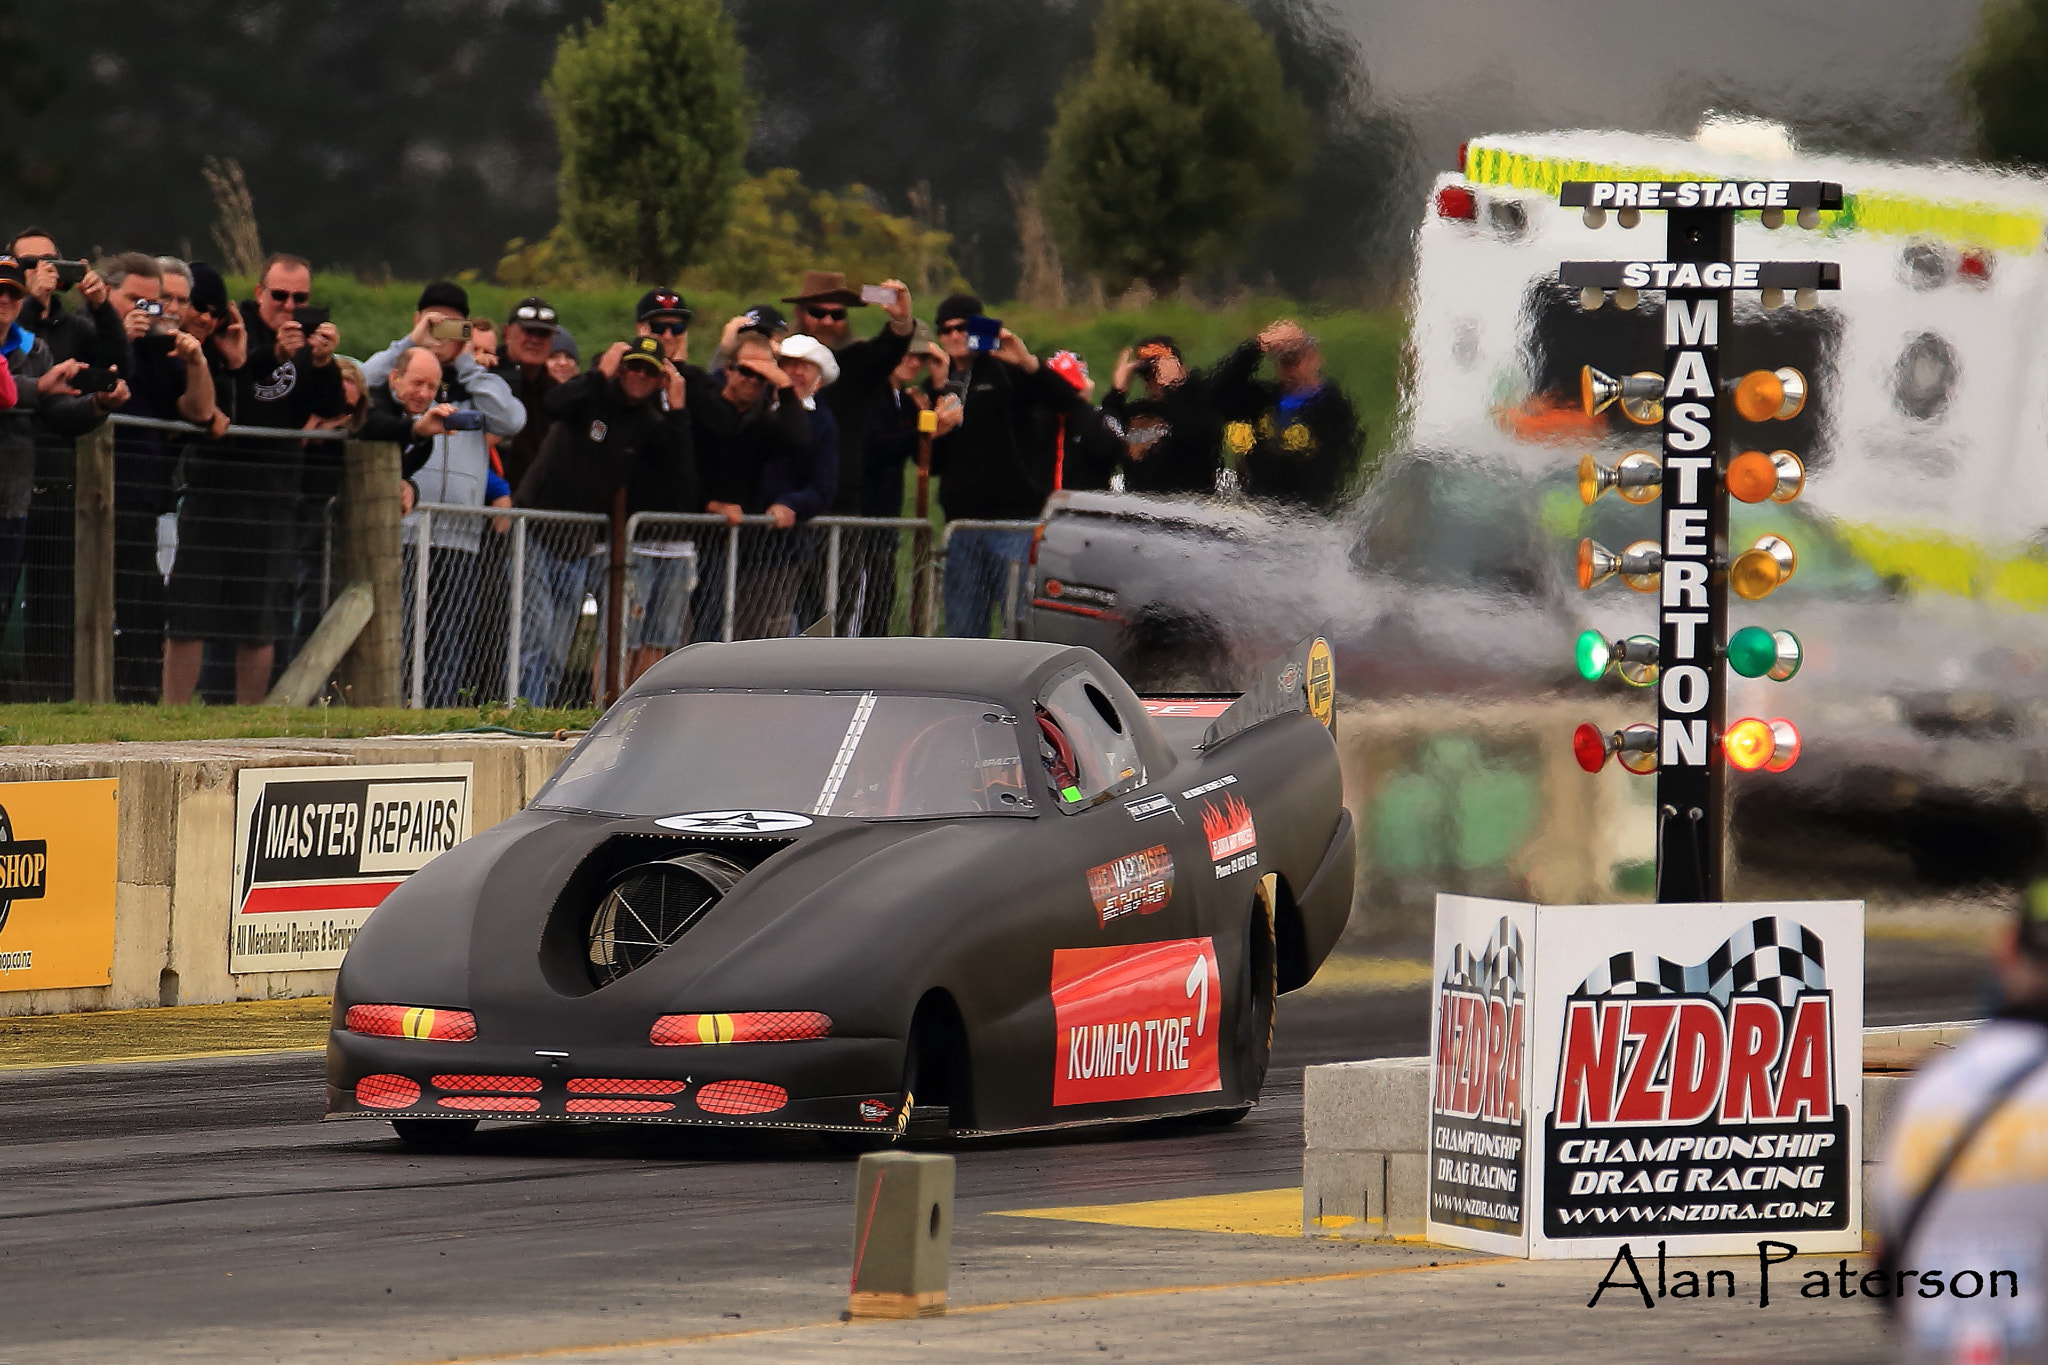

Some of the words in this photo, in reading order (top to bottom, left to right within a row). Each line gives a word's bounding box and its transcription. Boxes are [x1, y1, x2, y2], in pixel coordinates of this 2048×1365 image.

[1592, 182, 1790, 208] PRE-STAGE
[1622, 262, 1761, 288] STAGE
[1661, 297, 1719, 767] MASTERTON
[264, 803, 359, 860] MASTER
[368, 798, 459, 854] REPAIRS
[236, 924, 247, 956] All
[248, 922, 290, 955] Mechanical
[291, 922, 319, 960] Repairs
[321, 920, 328, 951] &
[1068, 1021, 1141, 1080] KUMHO
[1145, 1016, 1192, 1073] TYRE
[1436, 988, 1522, 1127] NZDRA
[1556, 995, 1835, 1130] NZDRA
[1435, 1126, 1522, 1160] CHAMPIONSHIP
[1559, 1132, 1836, 1164] CHAMPIONSHIP
[1438, 1157, 1470, 1185] DRAG
[1471, 1163, 1517, 1192] RACING
[1570, 1169, 1679, 1196] DRAG
[1685, 1165, 1825, 1193] RACING
[1434, 1192, 1520, 1222] WWW.NZDRA.CO.NZ
[1558, 1200, 1836, 1225] WWW.NZDRA.CO.NZ
